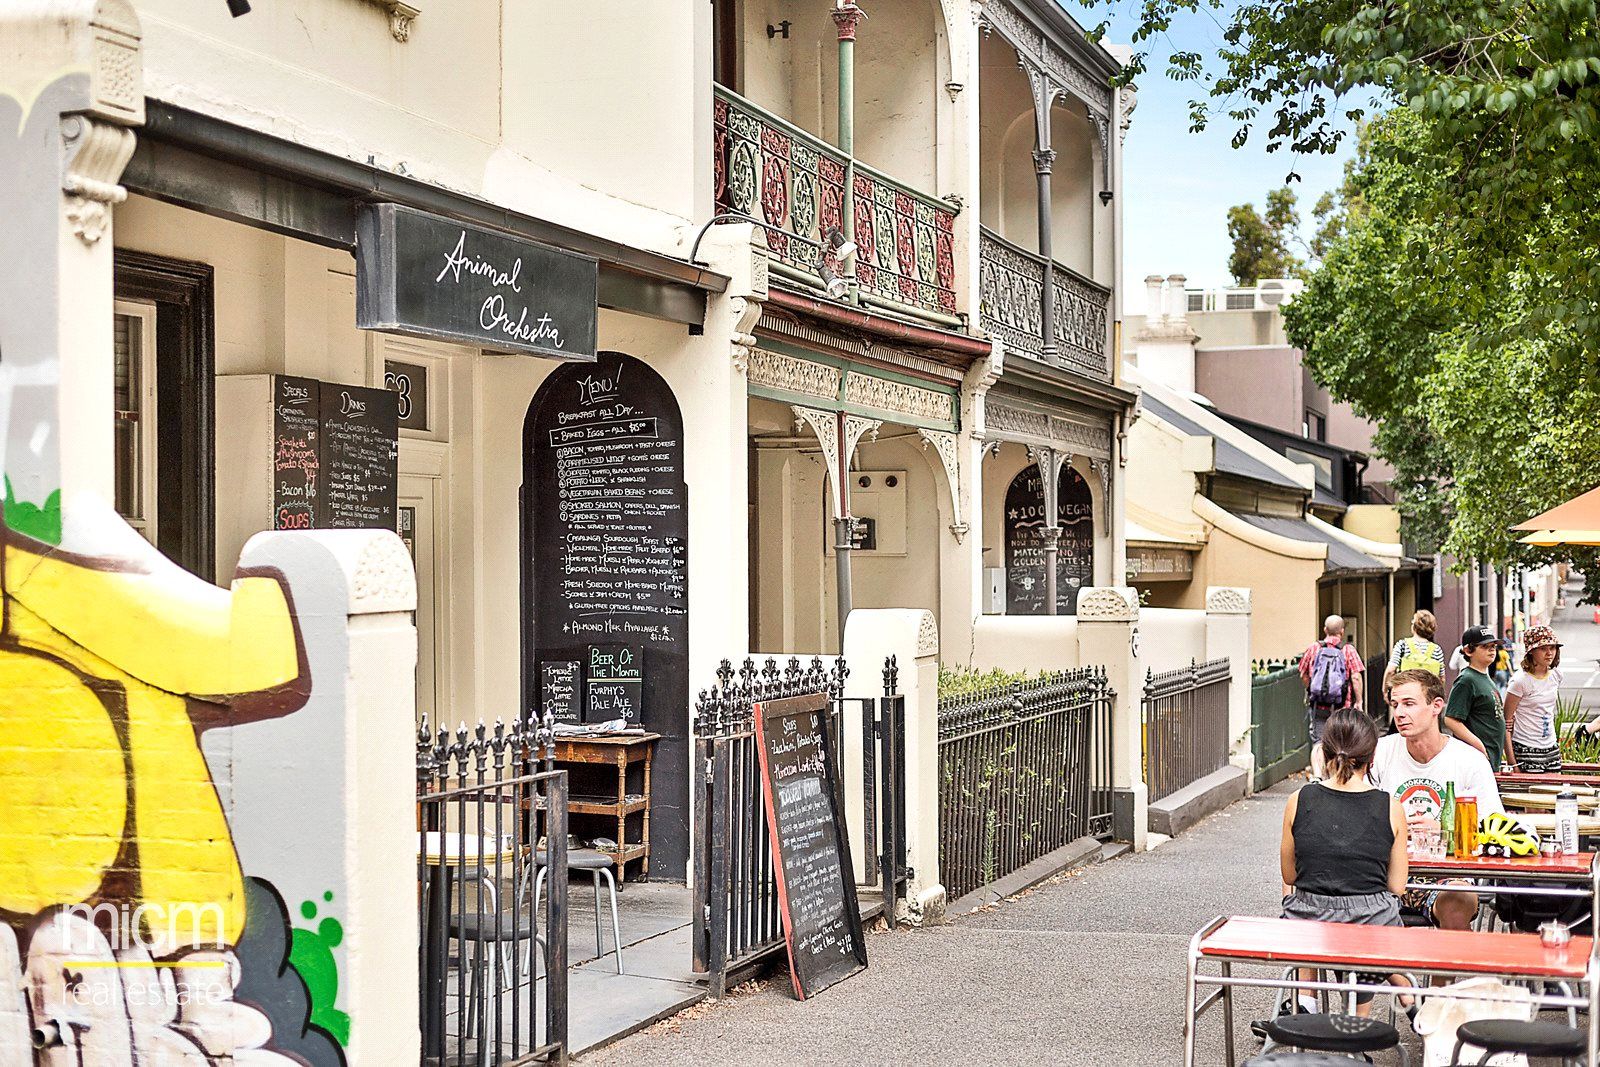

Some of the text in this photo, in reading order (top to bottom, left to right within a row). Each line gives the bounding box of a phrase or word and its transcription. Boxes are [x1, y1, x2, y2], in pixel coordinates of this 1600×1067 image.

[436, 230, 522, 292] Animal
[480, 294, 565, 348] Orchestra
[577, 362, 623, 404] MENU!
[558, 409, 597, 425] BREAKFAST
[599, 408, 614, 417] ALL
[560, 430, 585, 442] BAKED
[1058, 503, 1092, 516] VEGAN
[280, 509, 310, 529] SOUPS
[1013, 557, 1047, 567] GOLDEN
[572, 619, 604, 635] ALMOND
[591, 648, 634, 665] BEER OF
[590, 664, 639, 678] THE MONTH
[589, 682, 625, 696] FURPHY'S
[590, 694, 632, 711] PALE ALE
[620, 706, 634, 721] $6
[1403, 779, 1442, 792] HOKKAIDO
